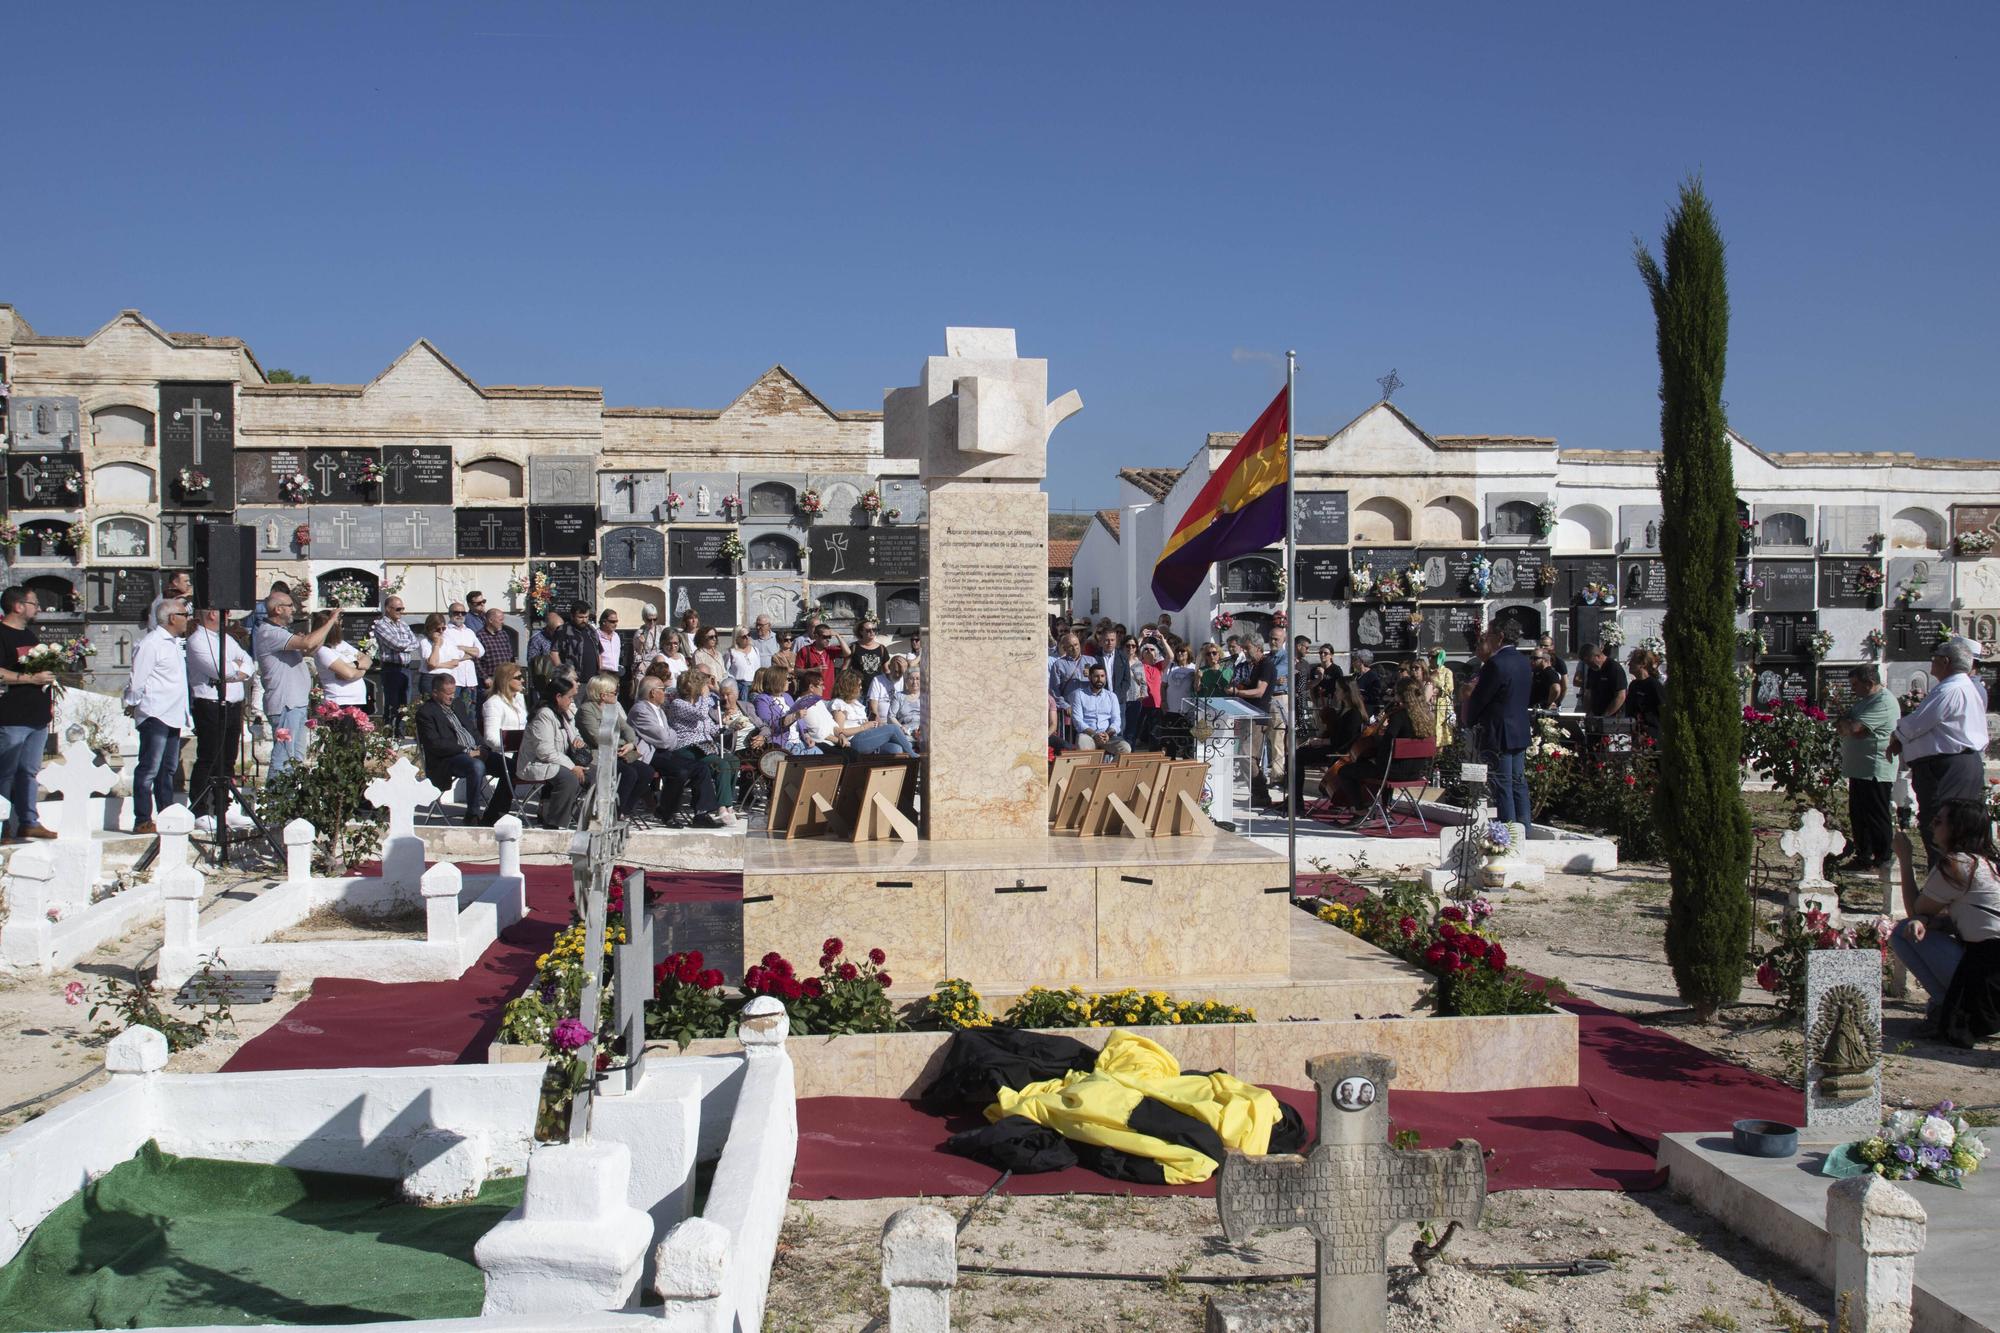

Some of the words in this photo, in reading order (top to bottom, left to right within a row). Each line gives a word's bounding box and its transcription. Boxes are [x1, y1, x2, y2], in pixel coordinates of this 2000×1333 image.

[1433, 1155, 1477, 1174] VILA
[1253, 1191, 1342, 1210] DOLORES
[1434, 1184, 1478, 1204] VILA
